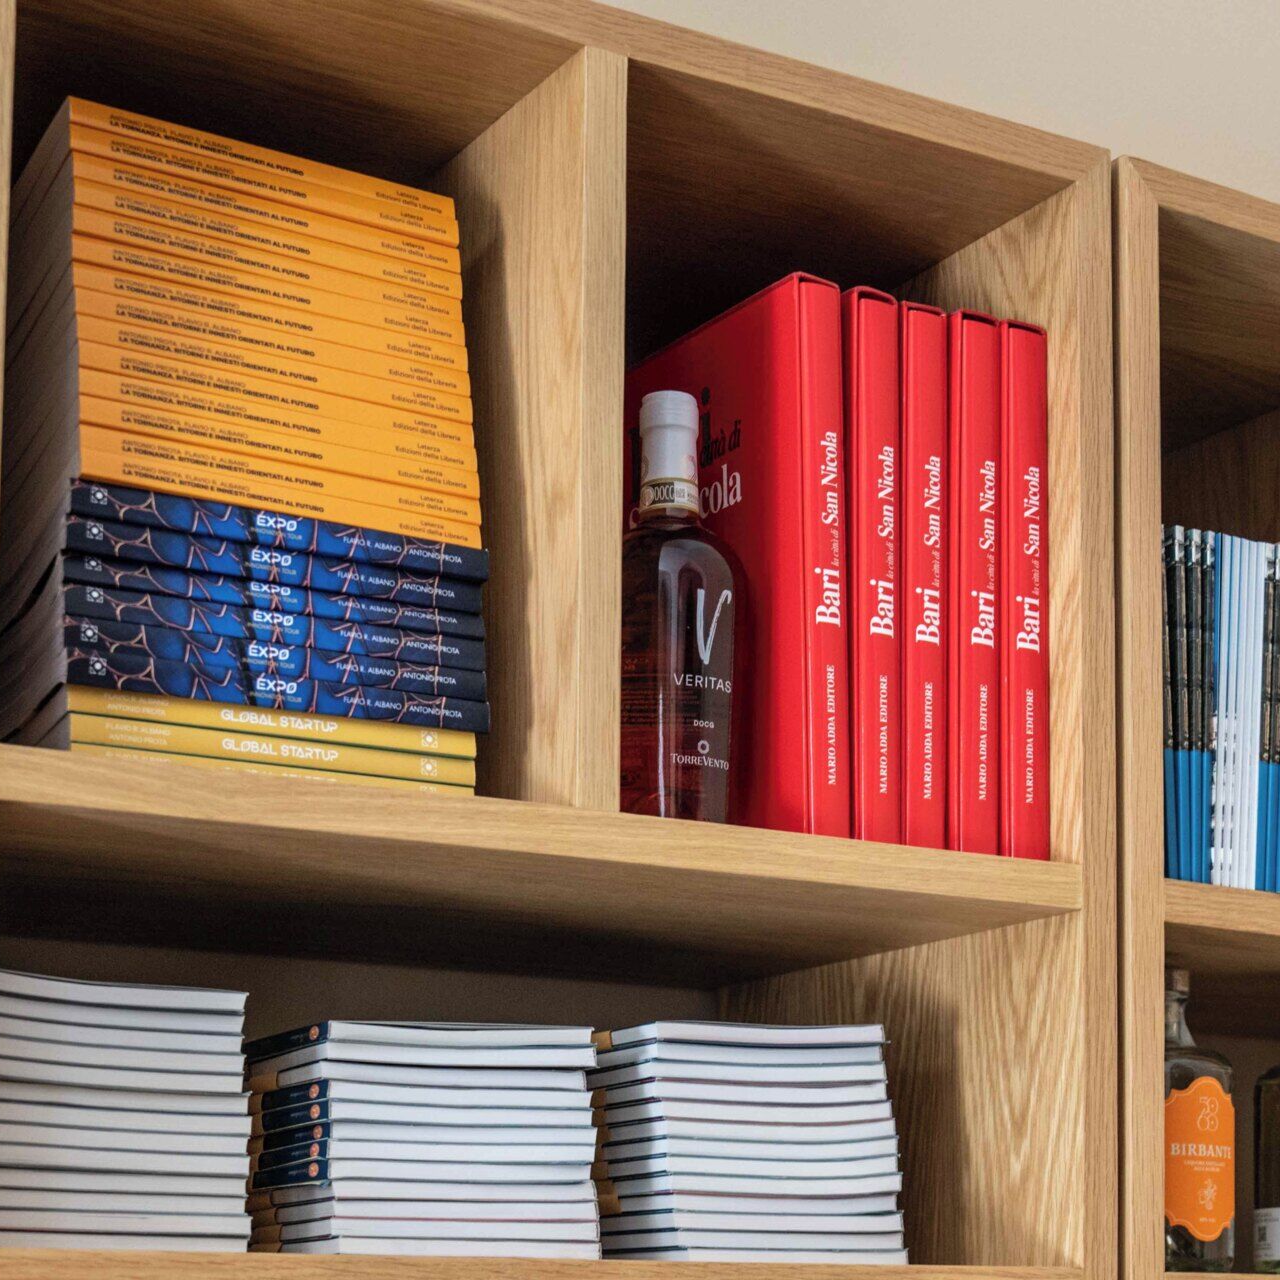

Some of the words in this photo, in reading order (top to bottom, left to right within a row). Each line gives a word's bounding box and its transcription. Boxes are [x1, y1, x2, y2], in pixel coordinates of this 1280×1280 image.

[821, 431, 838, 488] Nicola
[878, 446, 894, 501] Nicola
[699, 463, 742, 519] cola
[924, 455, 940, 510] Nicola
[980, 460, 995, 513] Nicola
[1024, 466, 1040, 519] Nicola
[295, 501, 324, 513] FUTURO
[822, 492, 838, 526] San
[878, 505, 894, 539] San
[924, 515, 940, 548] San
[979, 518, 995, 551] San
[1024, 524, 1040, 557] San
[374, 542, 402, 553] ALBANO
[409, 548, 441, 560] ANTONIO
[442, 552, 462, 564] PROTA
[815, 567, 840, 627] Bari
[870, 579, 894, 639] Bari
[915, 587, 940, 646] Bari
[971, 590, 994, 648] Bari
[1016, 595, 1040, 653] Bari
[673, 673, 732, 694] VERITAS
[827, 664, 836, 713] EDITORE
[280, 716, 338, 733] STARTUP
[694, 719, 715, 729] DOCG
[924, 682, 932, 729] EDITORE
[1026, 689, 1034, 735] EDITORE
[828, 716, 836, 745] ADDA
[924, 732, 932, 760] ADDA
[280, 744, 339, 762] STARTUP
[828, 747, 837, 785] MARIO
[924, 762, 932, 800] MARIO
[1171, 1143, 1232, 1159] BIRBANTE
